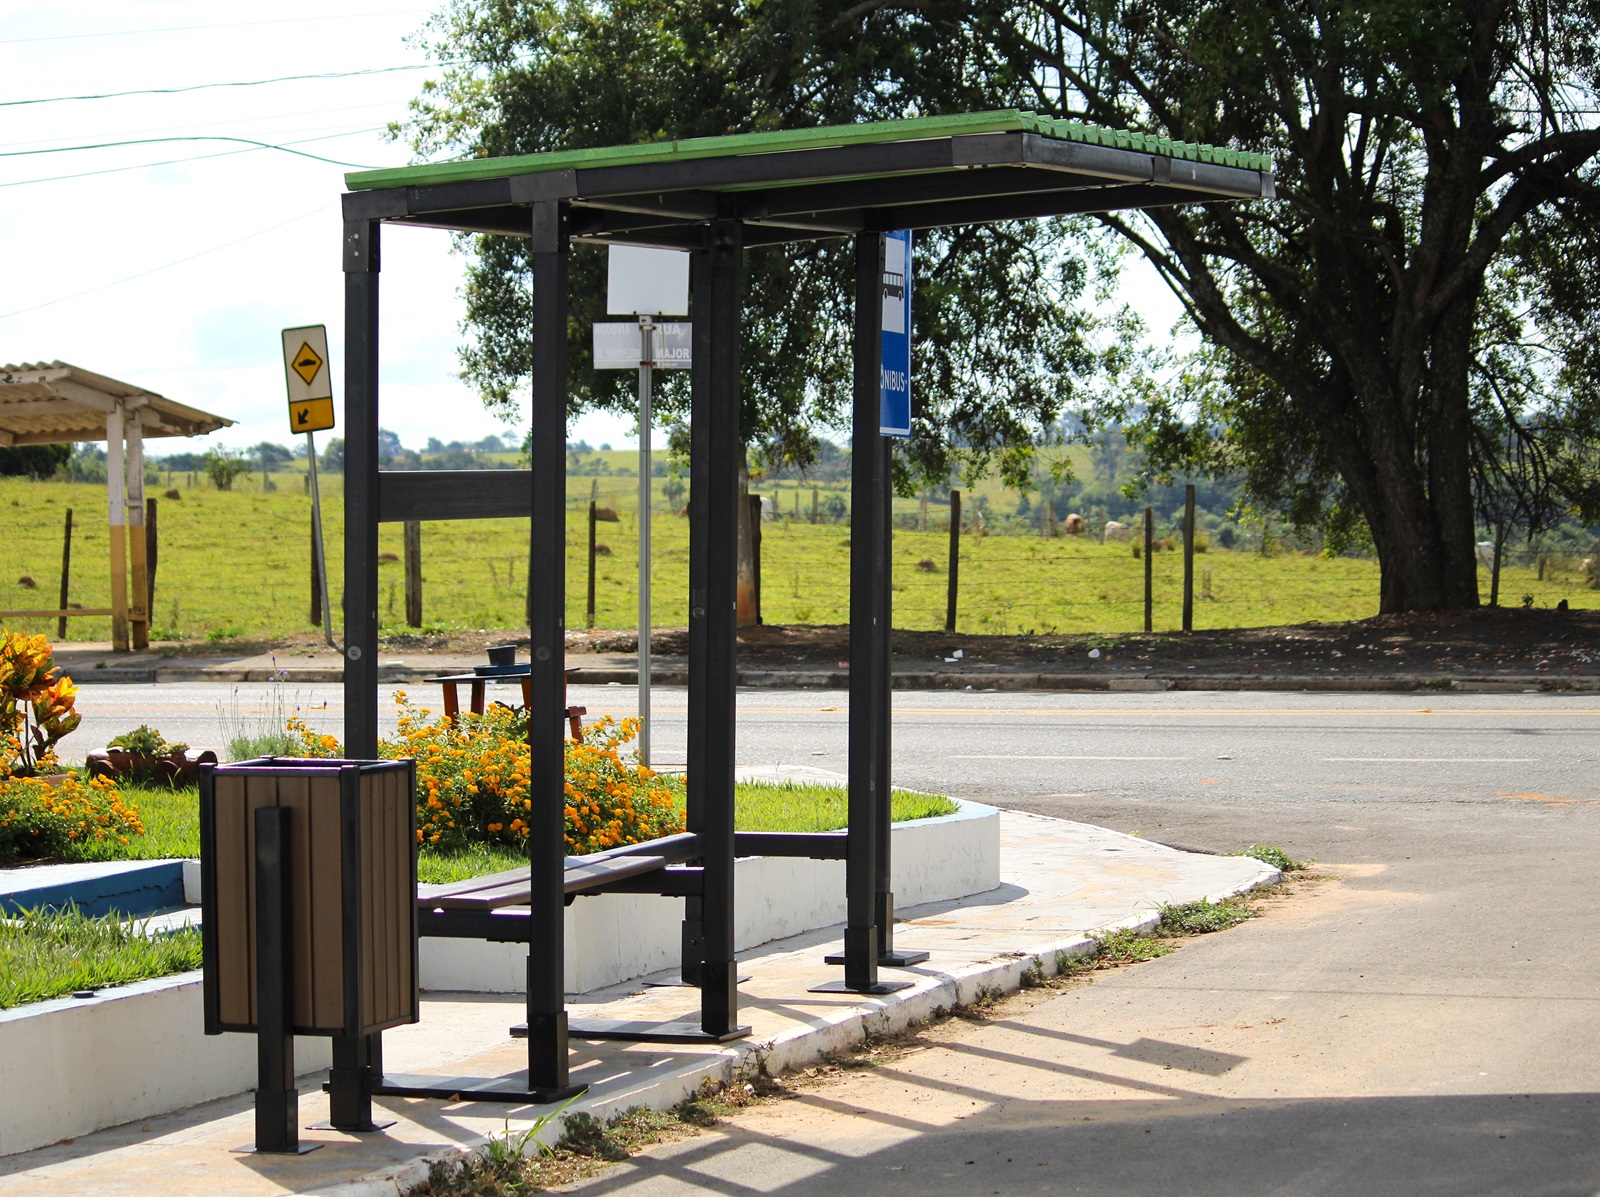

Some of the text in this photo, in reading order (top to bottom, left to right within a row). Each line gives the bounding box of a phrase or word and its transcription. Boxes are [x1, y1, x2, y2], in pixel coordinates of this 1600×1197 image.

[594, 324, 630, 335] RODOVIA
[656, 323, 681, 335] RUA
[655, 347, 690, 359] MAJOR
